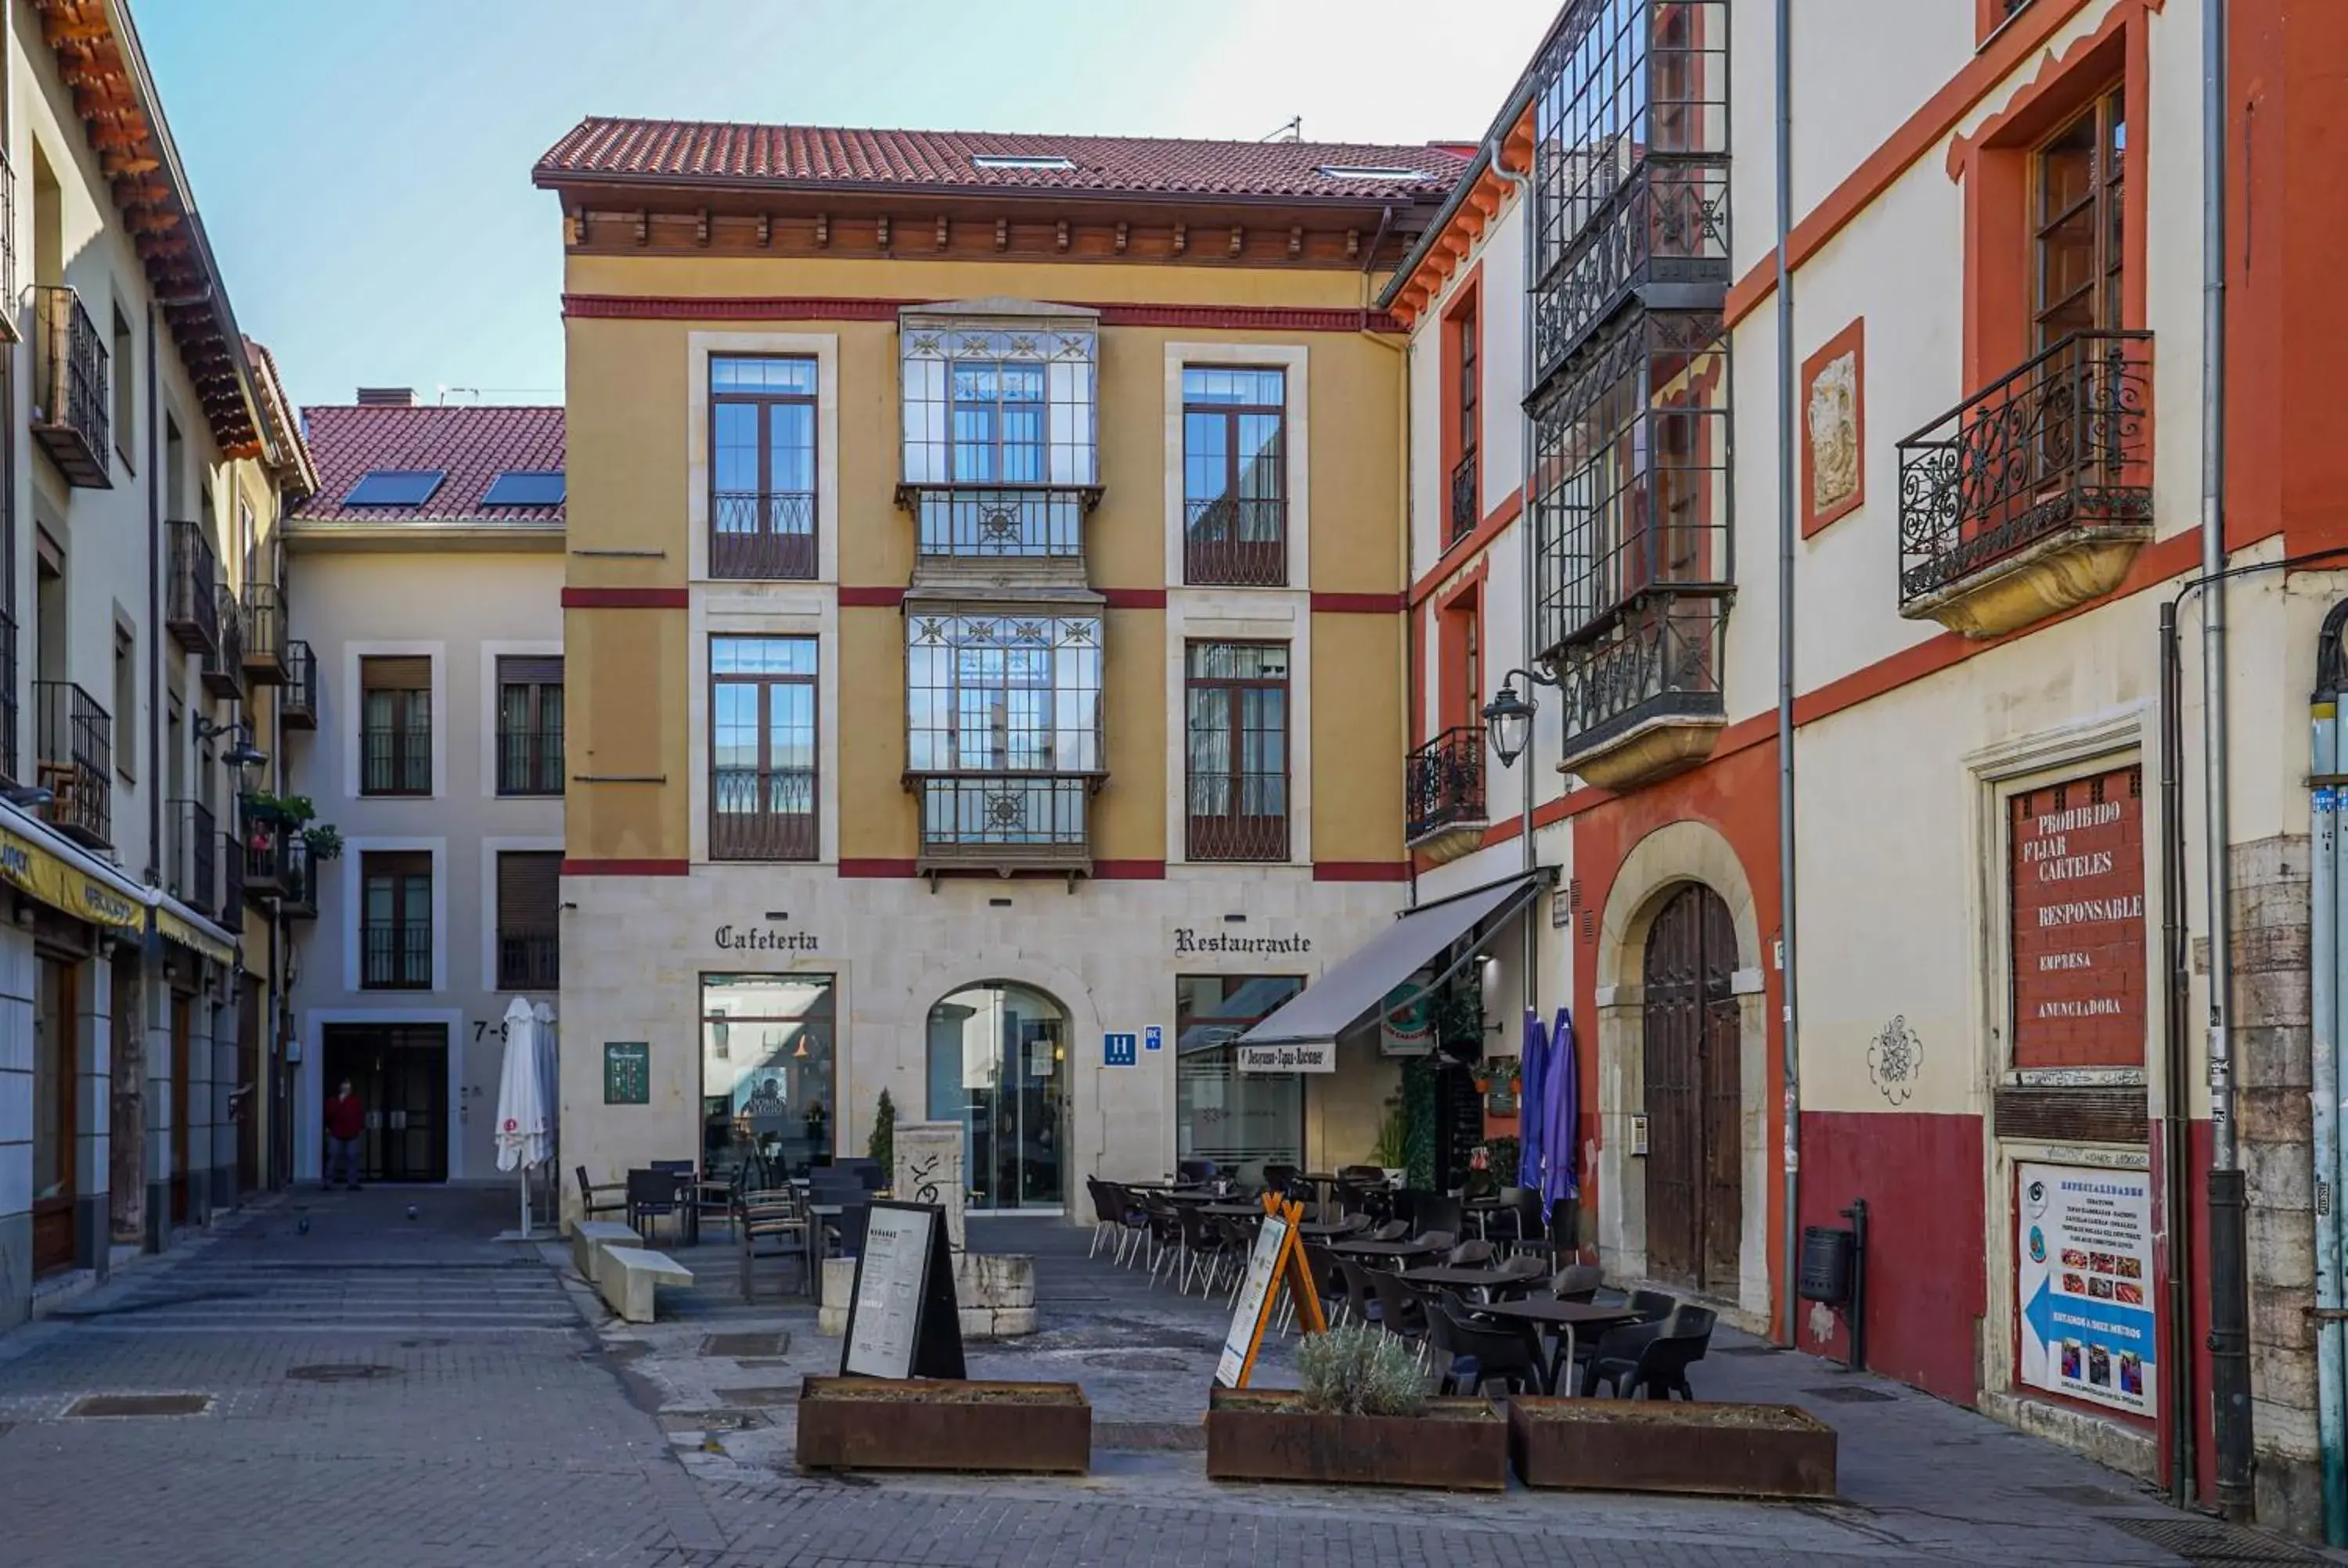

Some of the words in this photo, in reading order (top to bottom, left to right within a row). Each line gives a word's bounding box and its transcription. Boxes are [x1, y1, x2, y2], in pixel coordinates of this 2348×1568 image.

[2039, 800, 2120, 836] PROHIBIDO
[2023, 836, 2066, 862] FIJAR
[2039, 851, 2112, 882] CARTELES
[2039, 895, 2143, 927] RESPONSABLE
[1175, 927, 1312, 960] Restaurante
[2040, 951, 2091, 970] EMPRESA
[2038, 998, 2122, 1018] ANUNCIADORA
[1114, 1037, 1127, 1055] H
